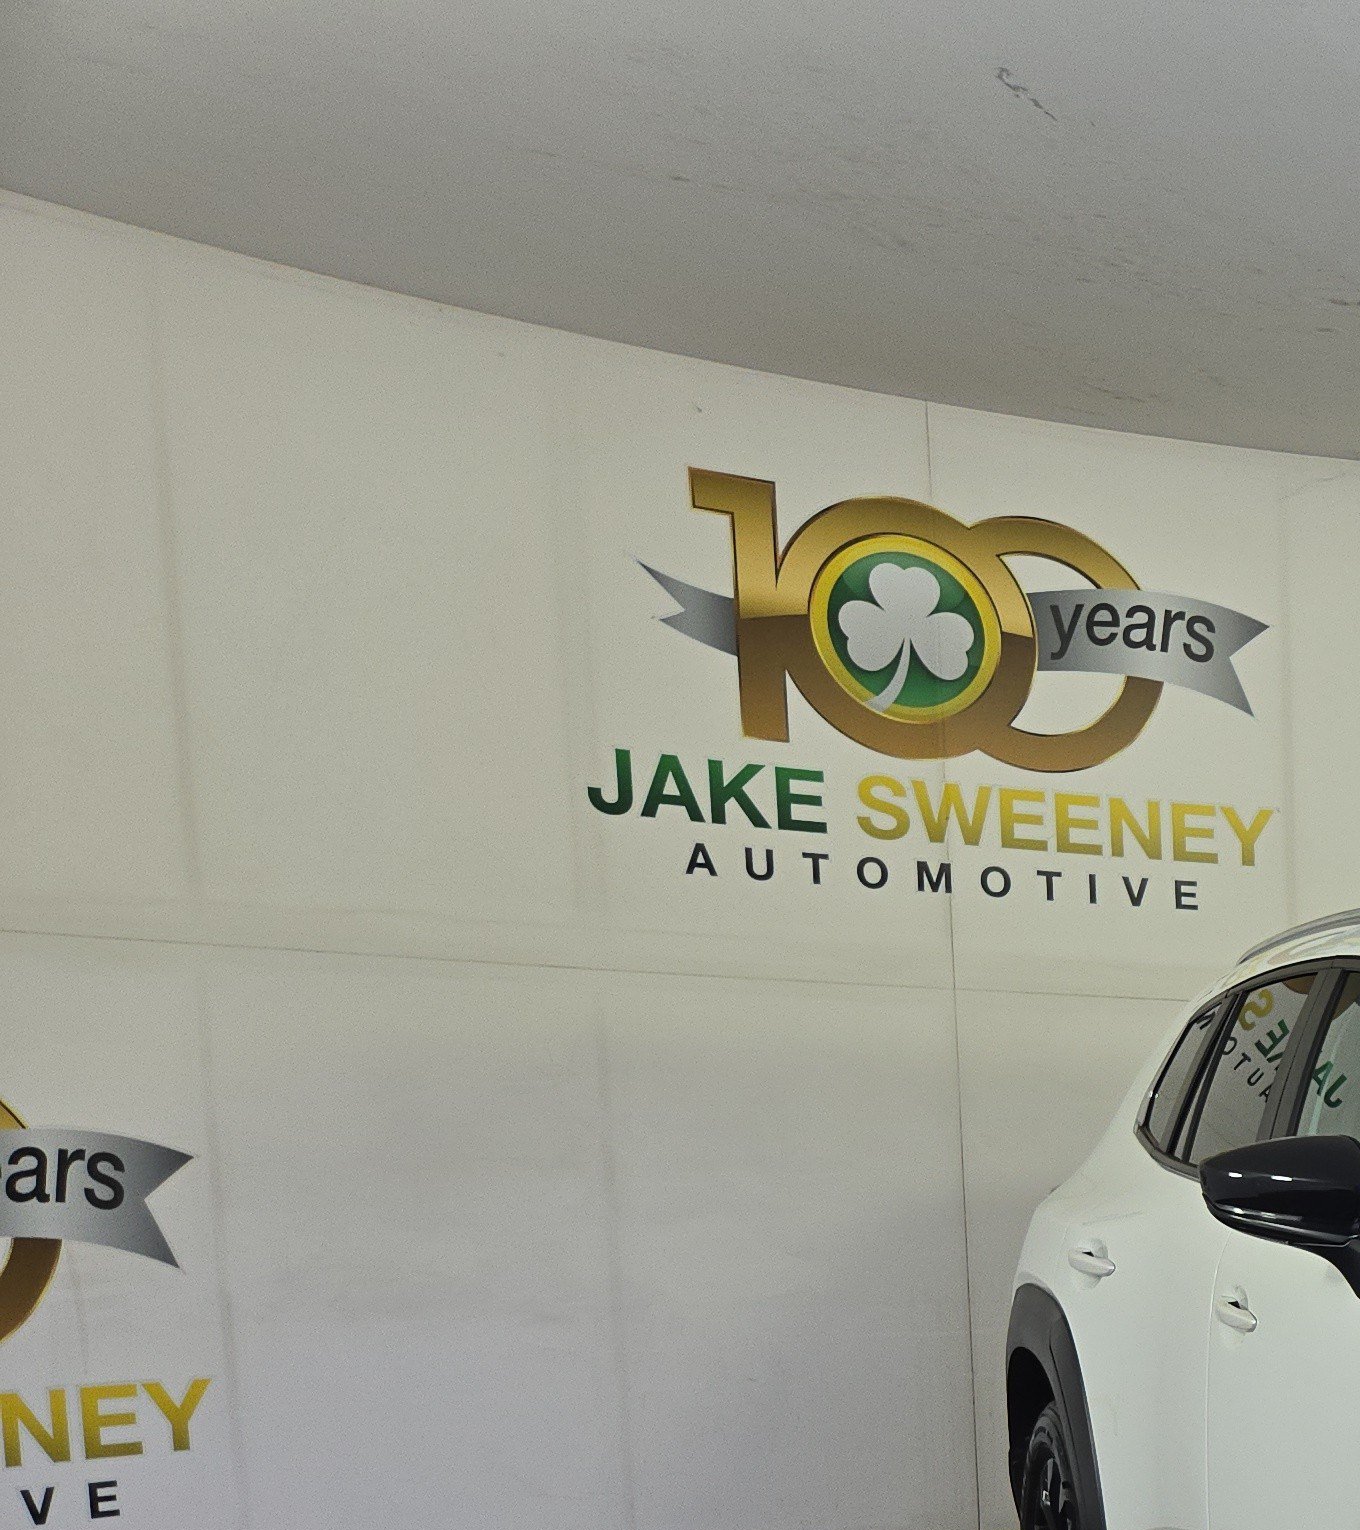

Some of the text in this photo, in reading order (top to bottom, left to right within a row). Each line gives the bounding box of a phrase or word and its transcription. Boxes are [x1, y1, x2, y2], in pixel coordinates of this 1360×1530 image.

[688, 467, 1216, 773] 100 years
[587, 748, 1274, 867] JAKE SWEENEY
[686, 843, 1199, 909] AUTOMOTIVE
[0, 1146, 125, 1210] ars
